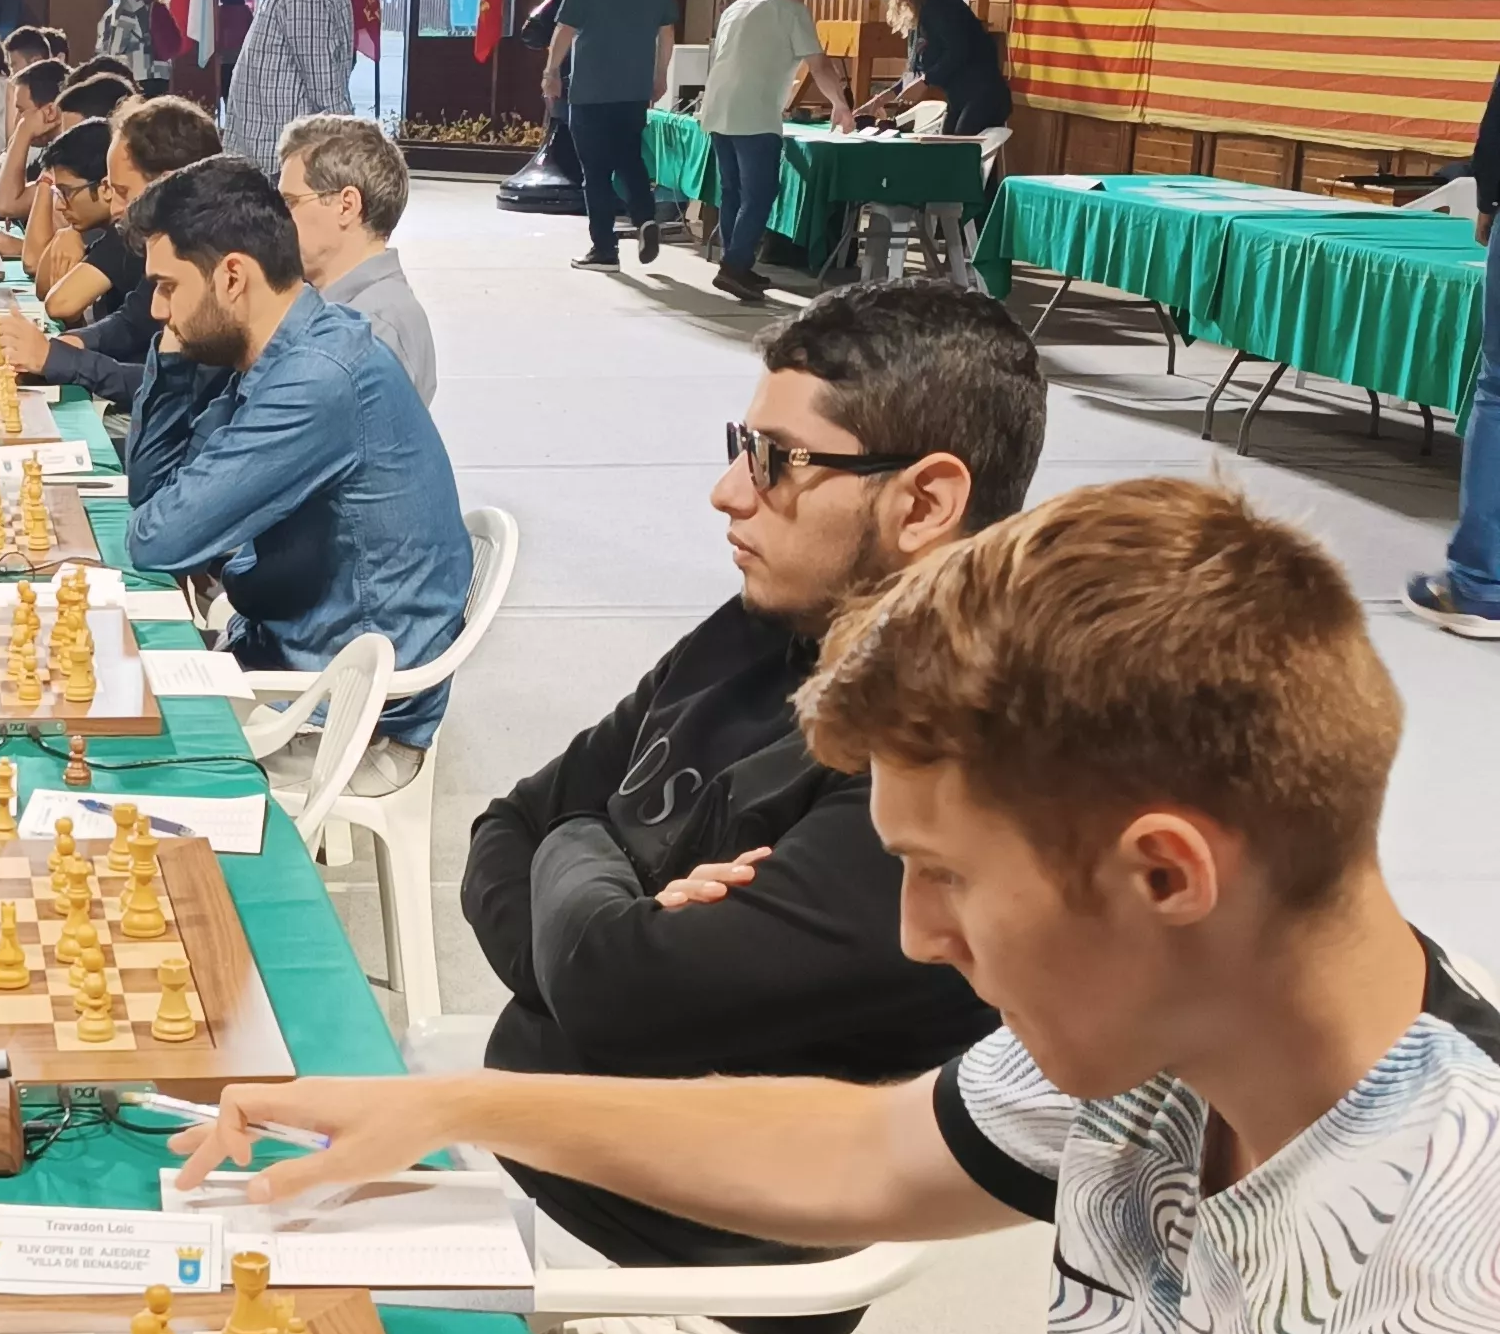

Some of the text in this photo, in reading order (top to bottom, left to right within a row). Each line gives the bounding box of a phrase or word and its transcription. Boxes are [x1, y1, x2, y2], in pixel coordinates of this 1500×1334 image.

[46, 1219, 104, 1234] Travadon
[43, 1244, 74, 1256] OPEN
[80, 1245, 94, 1256] DE
[100, 1247, 151, 1259] AJEDREZ
[65, 1257, 80, 1269] DE
